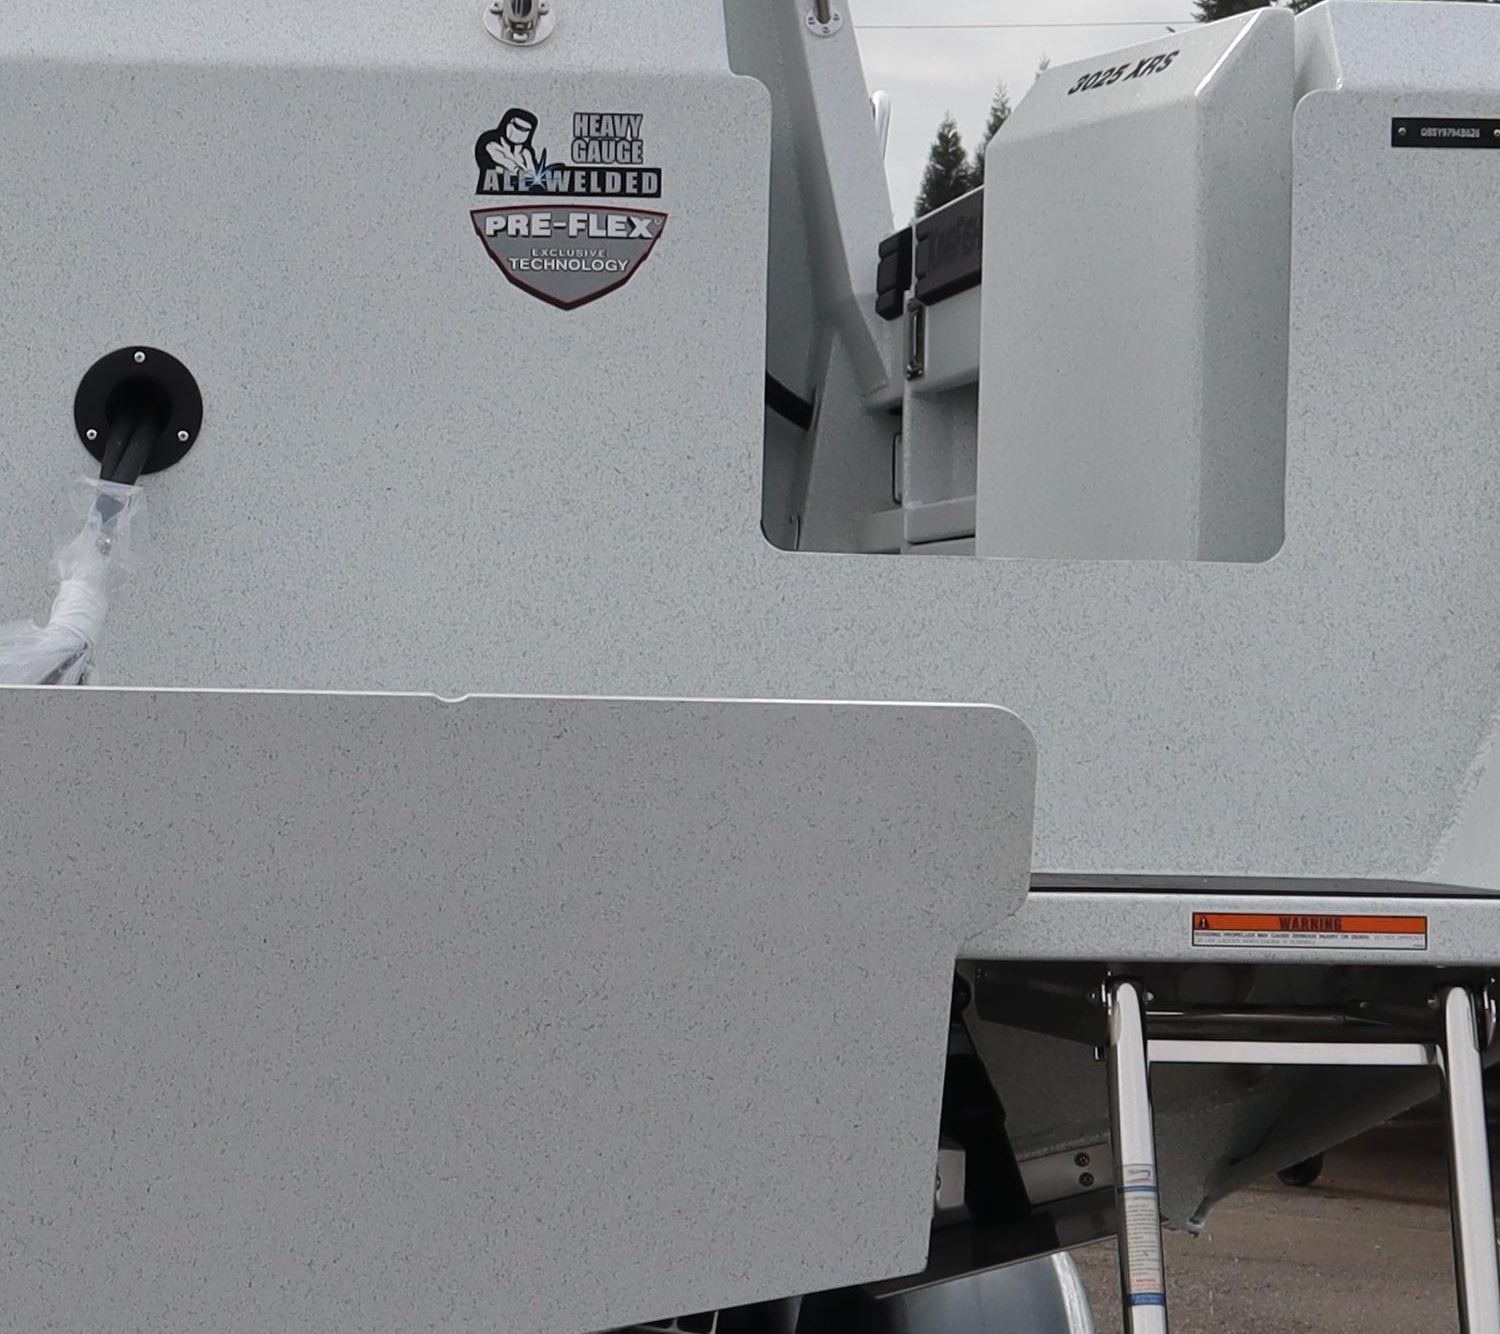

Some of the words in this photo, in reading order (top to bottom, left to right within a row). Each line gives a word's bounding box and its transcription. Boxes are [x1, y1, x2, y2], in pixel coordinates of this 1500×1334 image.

[1067, 62, 1131, 95] 3025
[1122, 49, 1180, 82] XRS
[573, 112, 644, 139] HEAVY
[571, 138, 644, 164] GAUGE
[547, 170, 659, 194] WELDED
[510, 258, 629, 271] TECHNOLOGY
[531, 249, 607, 257] EXCLUSIVE
[1280, 917, 1342, 931] WARNING
